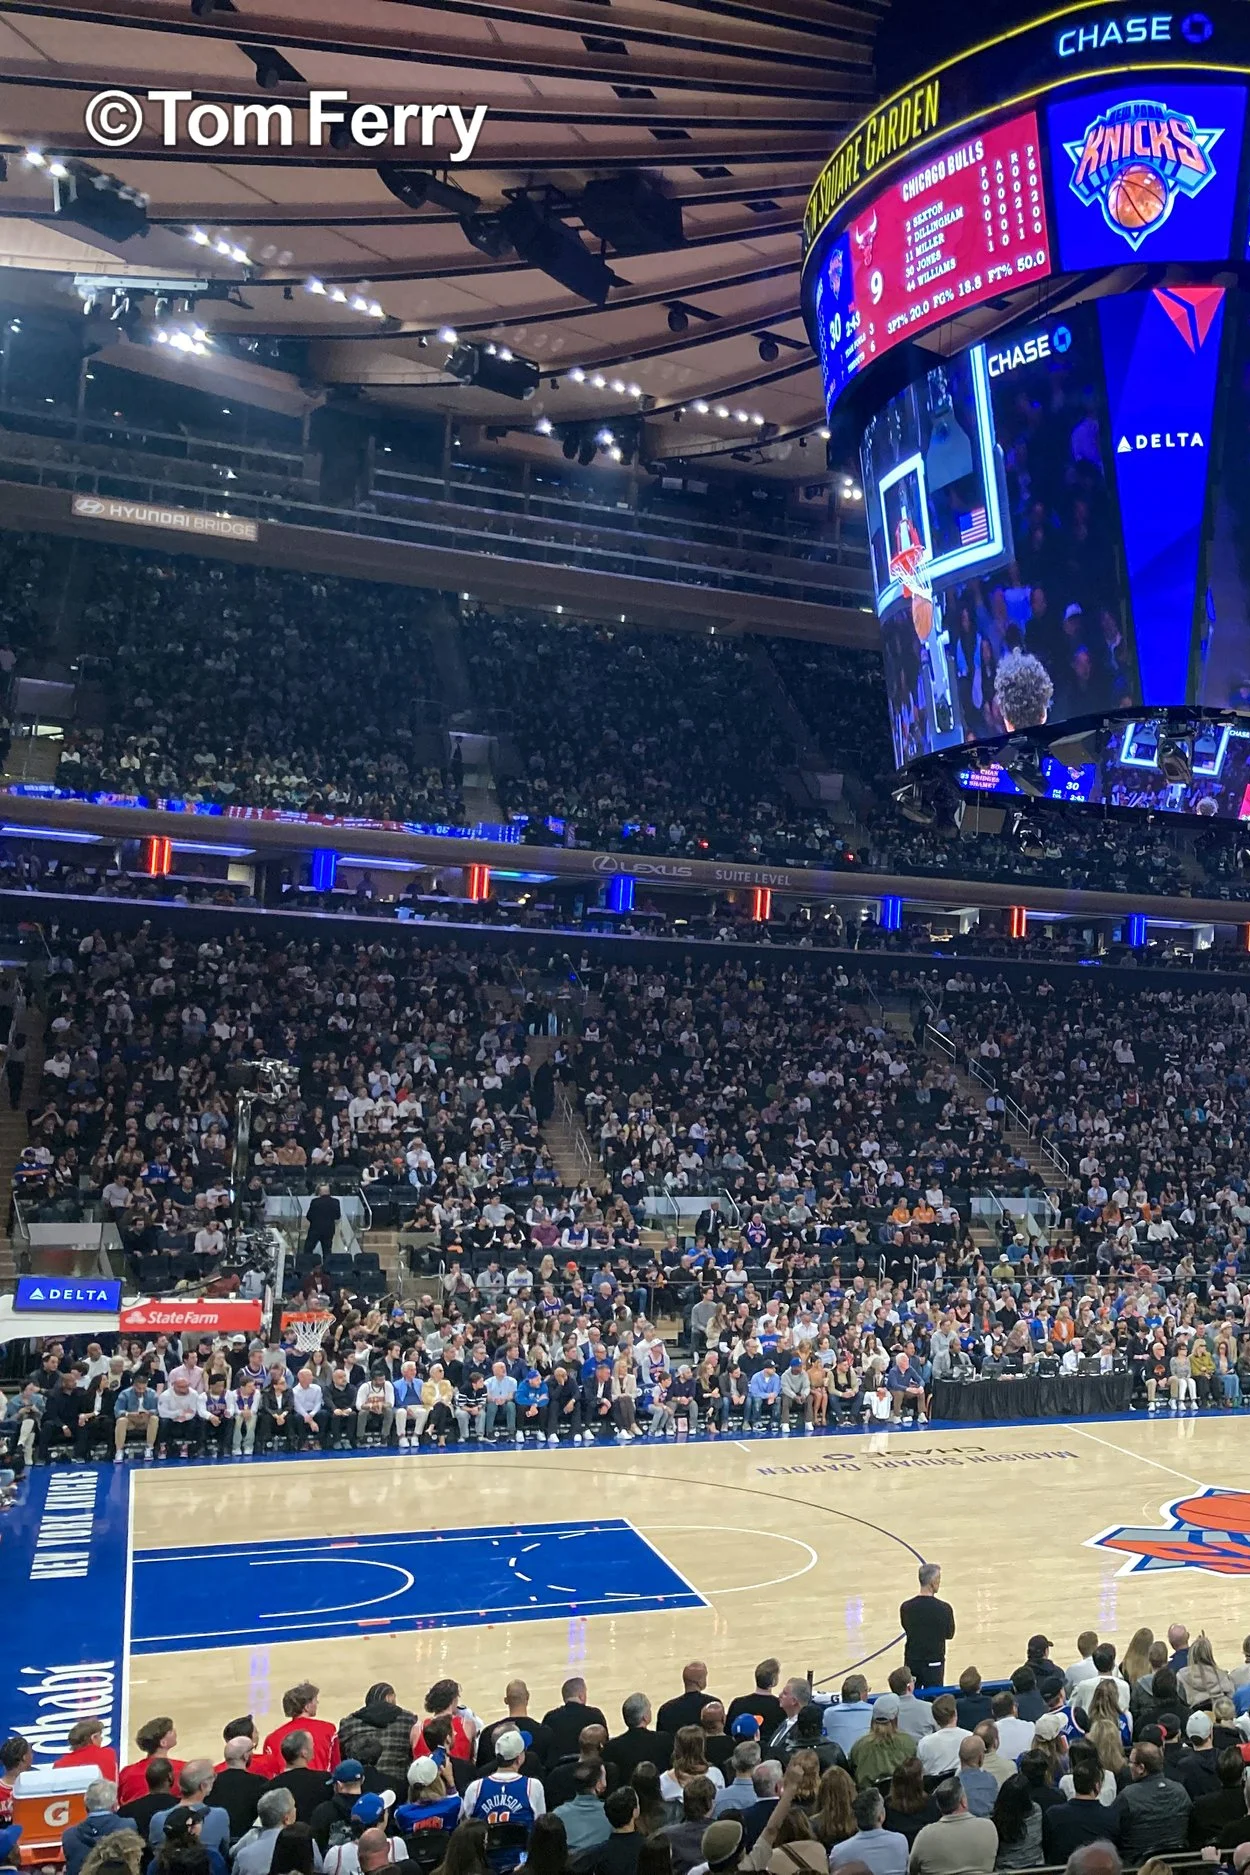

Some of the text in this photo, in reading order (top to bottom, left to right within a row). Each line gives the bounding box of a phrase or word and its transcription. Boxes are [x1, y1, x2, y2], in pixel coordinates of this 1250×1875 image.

[1058, 16, 1172, 56] CHASE
[818, 135, 862, 223] SQUARE
[865, 80, 939, 170] GARDEN
[1075, 117, 1207, 185] KNICKS
[903, 140, 984, 202] CHICAGO BULLS
[912, 201, 943, 227] SEXTON
[914, 206, 964, 242] DILLINGHAM
[905, 233, 945, 263] 11 MILLER
[905, 250, 941, 278] 30 JONES
[917, 258, 956, 286] WILLIAMS
[871, 271, 883, 305] 9
[888, 251, 1045, 335] 3PT% 20.0 FG% 18.8 FT% 50.0
[988, 334, 1051, 378] CHASE
[1136, 432, 1204, 450] DELTA
[110, 504, 257, 538] HYUNDAI BRIDGE
[620, 862, 792, 887] LEXUS SUITE LEVEL
[50, 1289, 107, 1301] DELTA
[757, 1450, 1079, 1477] MADISON SQUARE GARDEN
[866, 1446, 987, 1459] CHASE
[30, 1471, 98, 1580] NEW YORK KNICKS
[44, 1800, 70, 1827] G
[481, 1794, 524, 1814] BRUNSON
